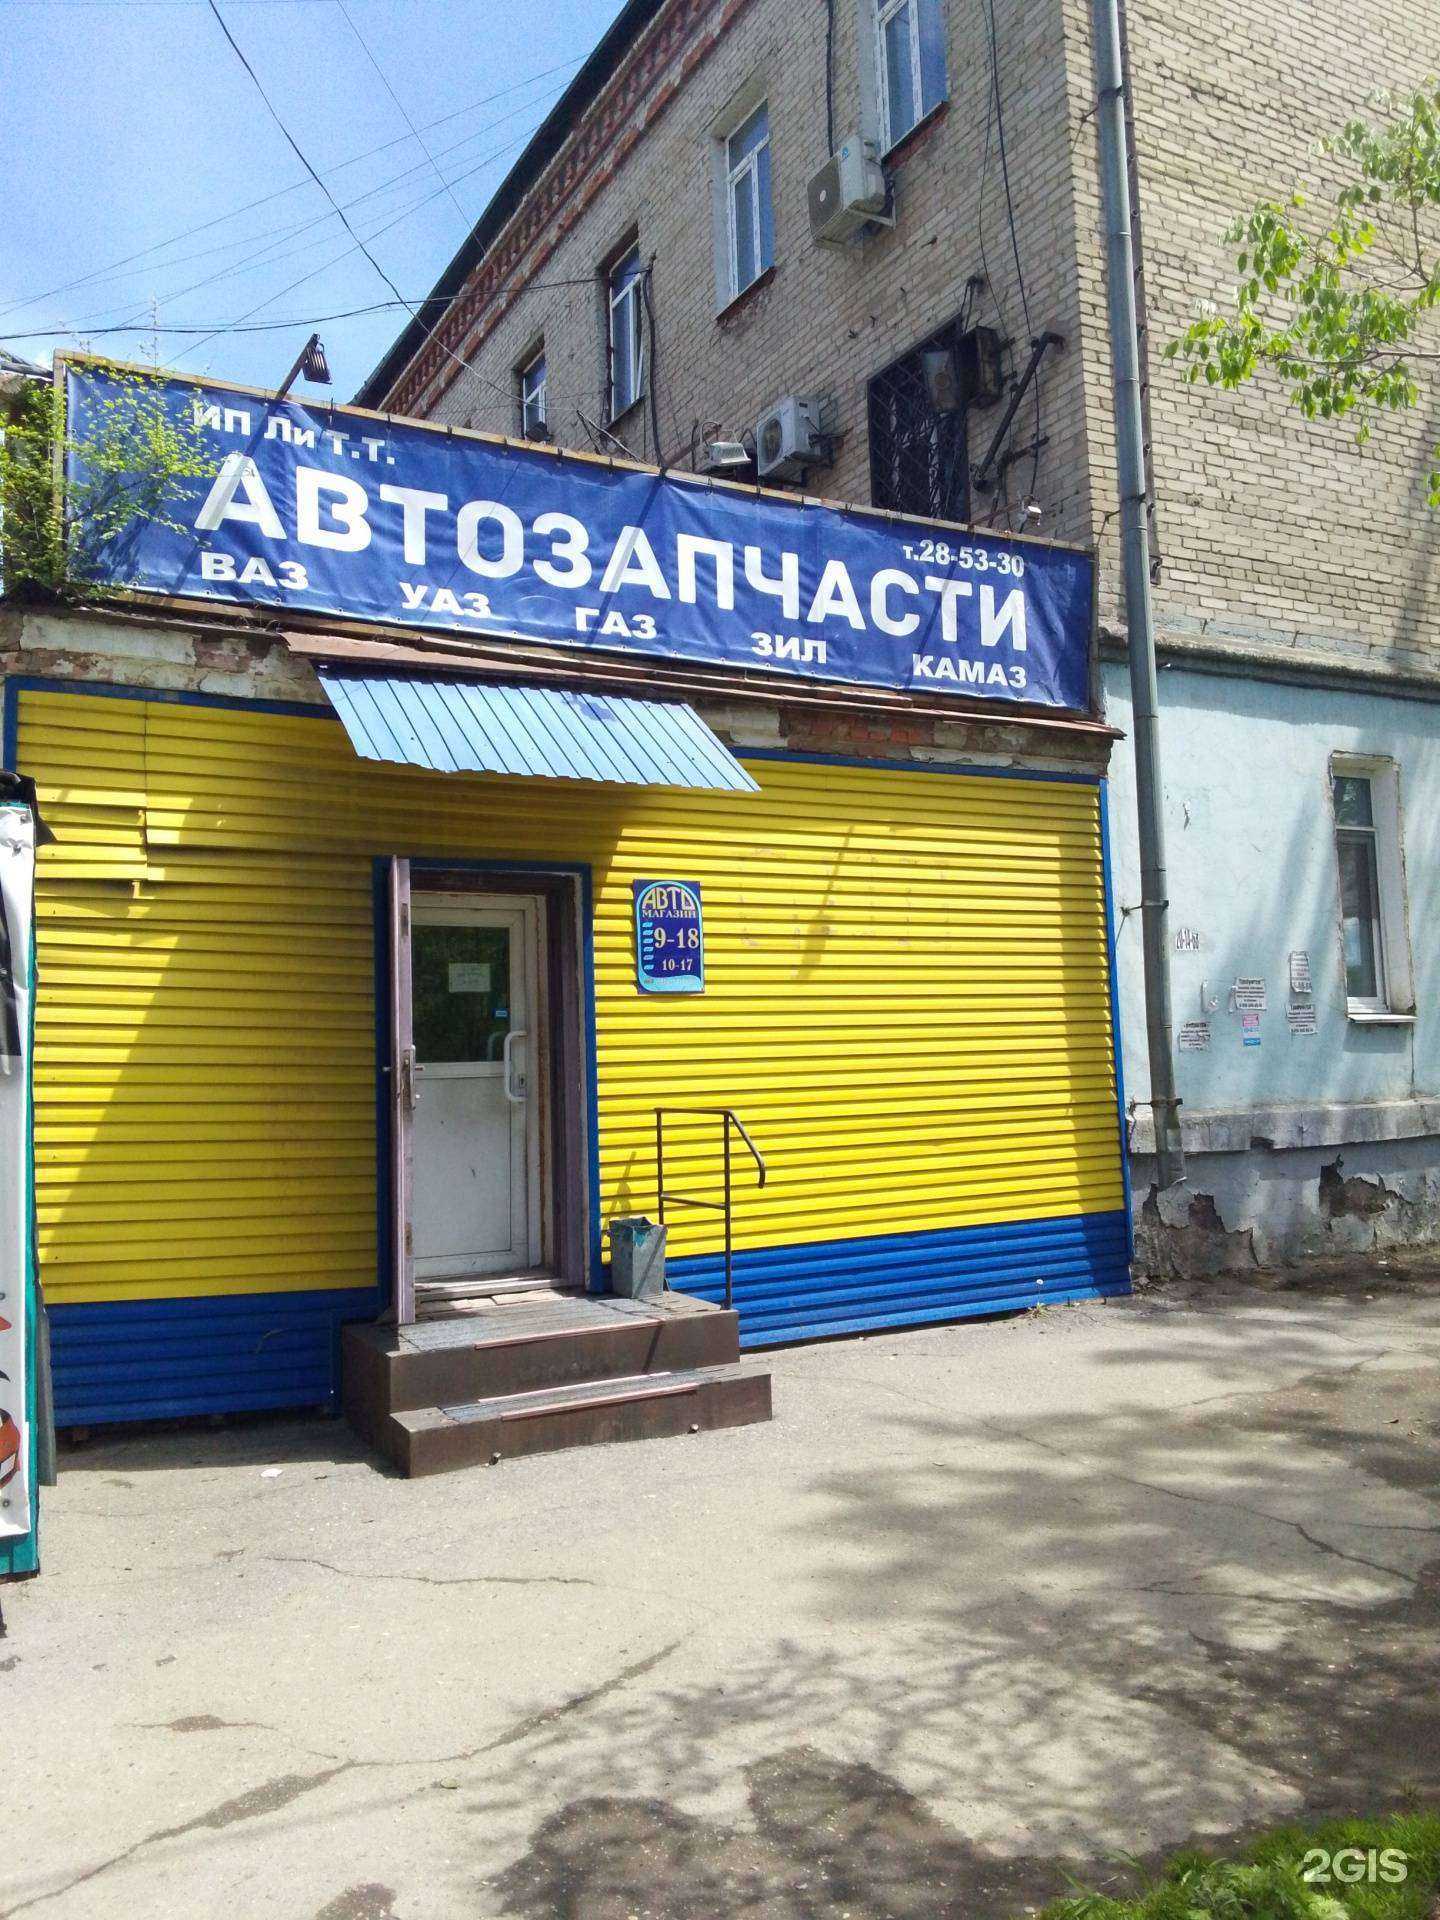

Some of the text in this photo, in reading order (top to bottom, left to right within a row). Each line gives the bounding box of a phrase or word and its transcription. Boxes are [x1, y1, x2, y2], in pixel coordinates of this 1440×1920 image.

[193, 404, 251, 436] ИП
[263, 415, 316, 449] Ли
[193, 451, 1028, 652] АВТОЗАПЧАСТИ
[201, 551, 309, 590] ВАЗ
[399, 583, 492, 619] УАЗ
[575, 606, 657, 640] ГАЗ
[750, 631, 828, 665] ЗИЛ
[912, 653, 1028, 689] КАМАЗ
[642, 909, 697, 919] МАГАЗИН
[653, 927, 700, 949] 9-18
[662, 958, 694, 971] 10-17
